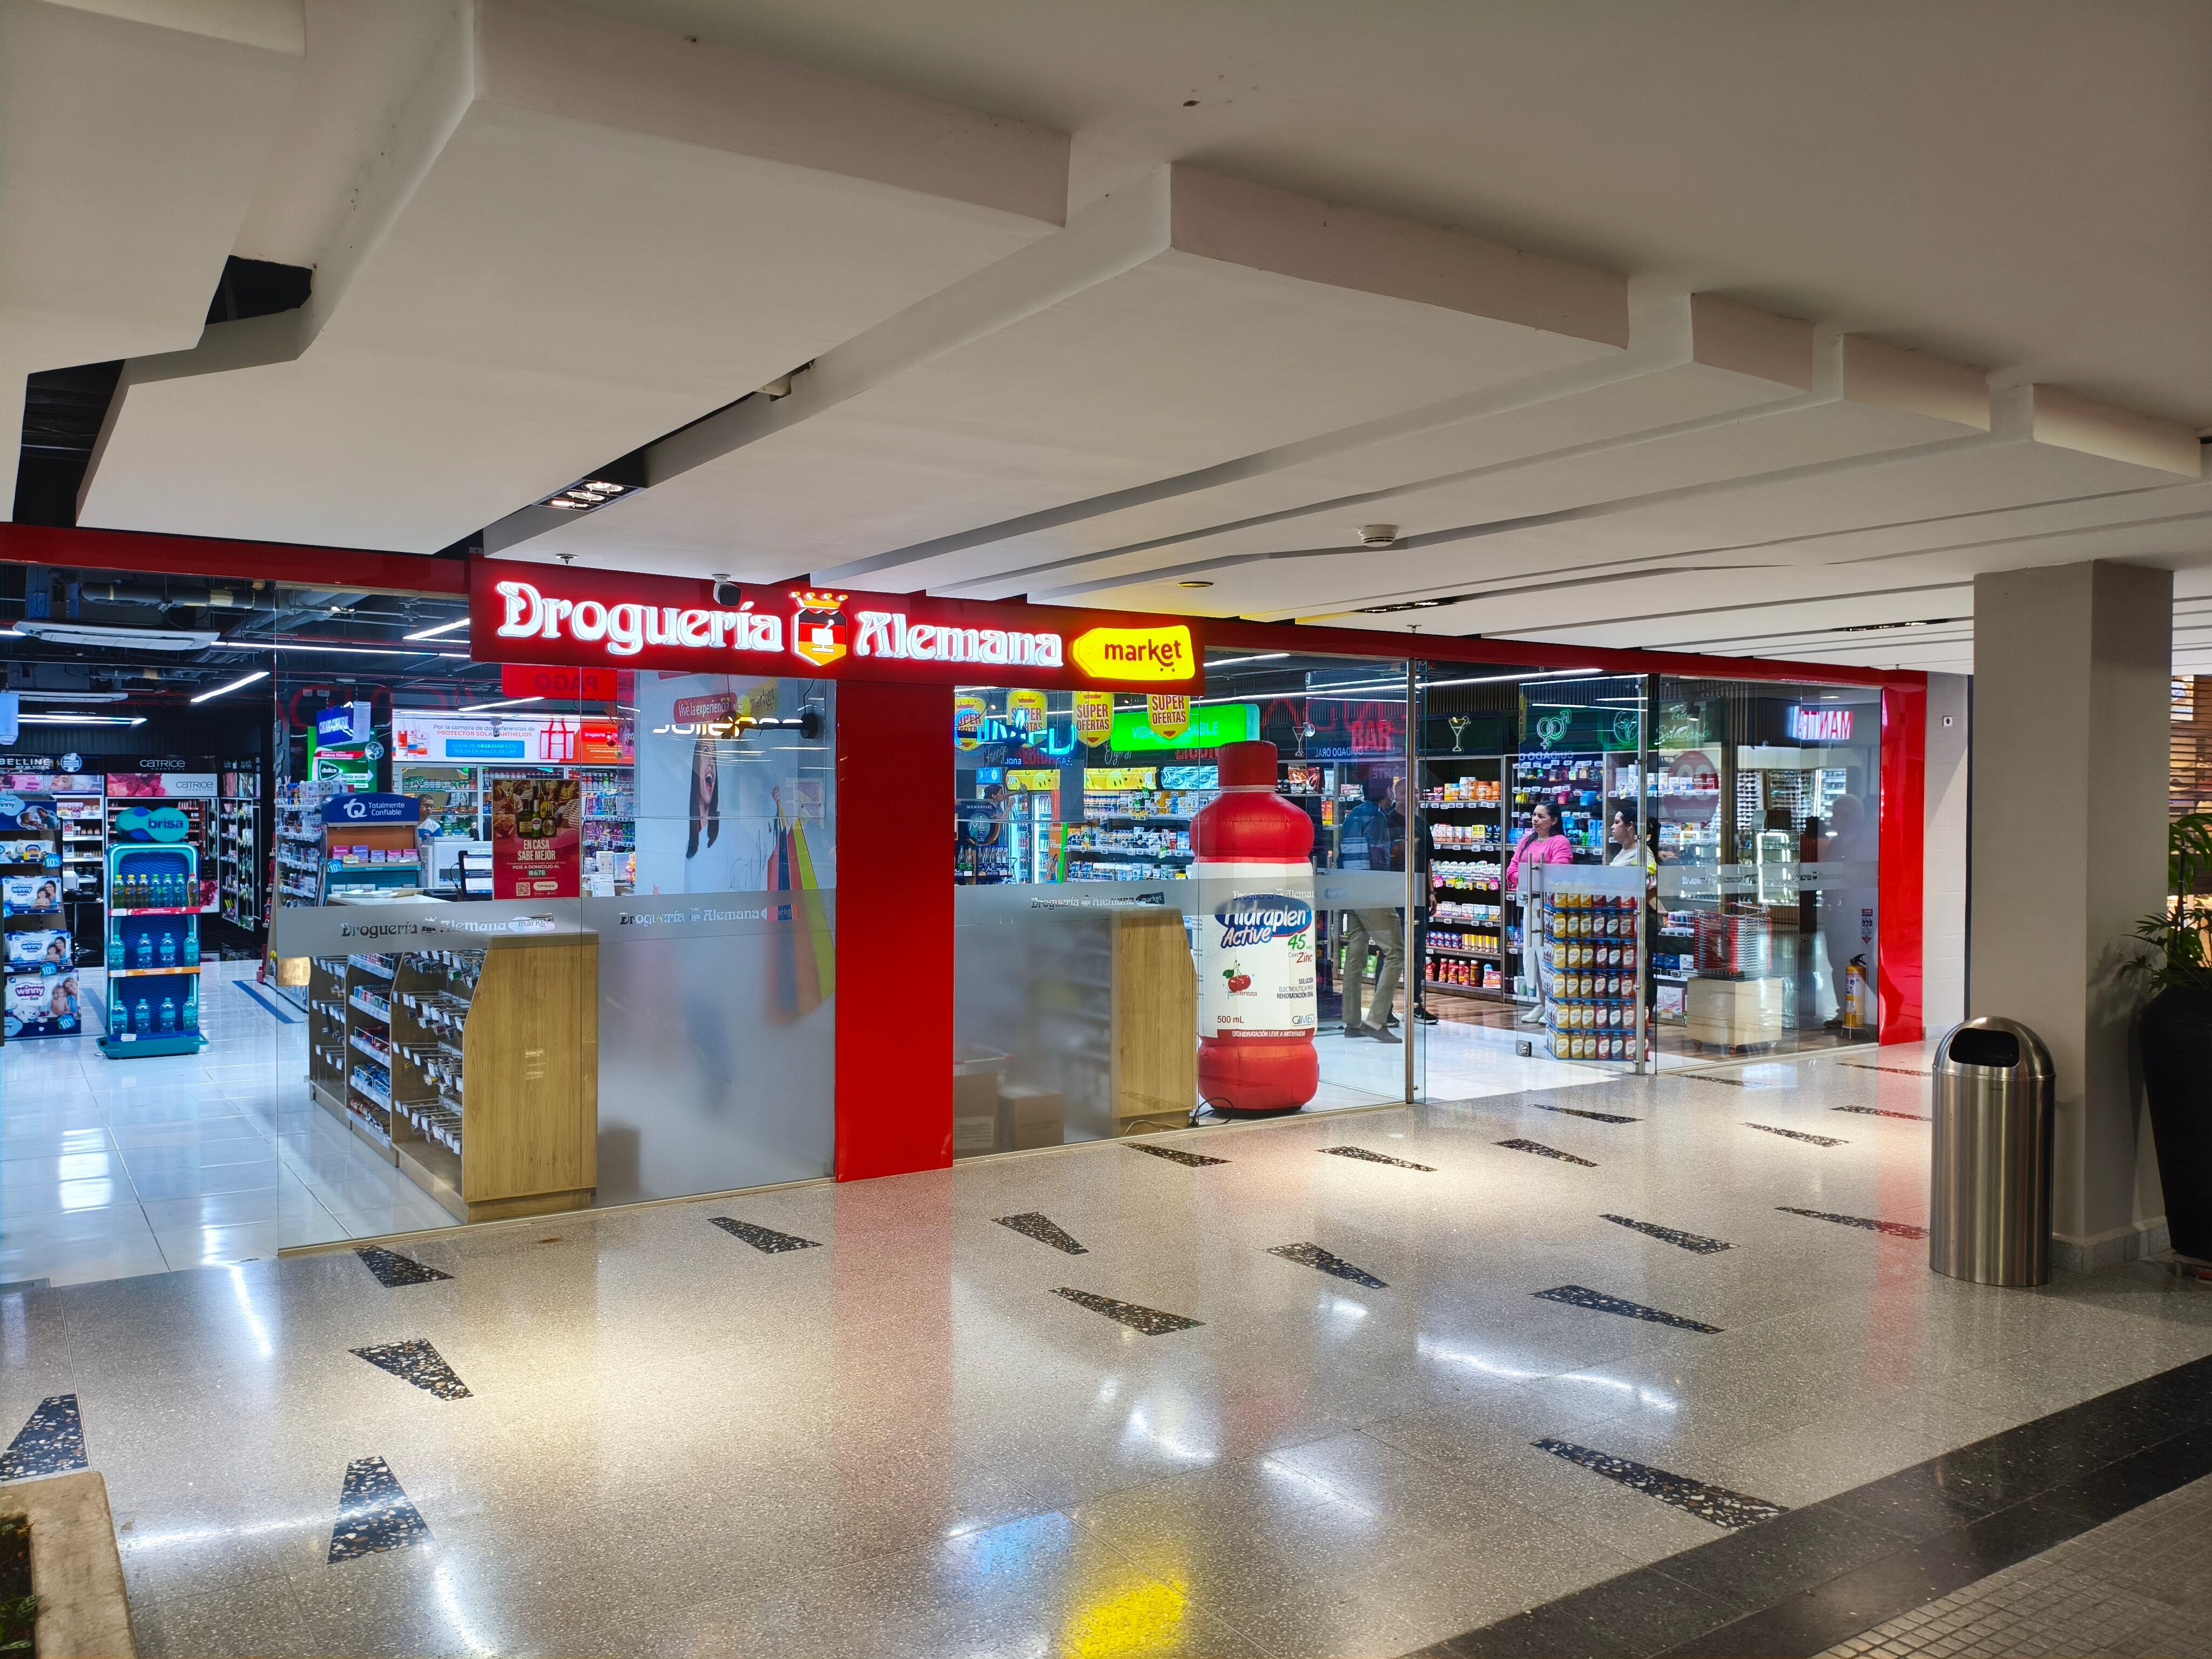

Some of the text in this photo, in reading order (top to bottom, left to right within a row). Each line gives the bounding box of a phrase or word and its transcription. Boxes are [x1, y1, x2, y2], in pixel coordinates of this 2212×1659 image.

[495, 581, 1063, 667] Droguería Alemana
[1104, 639, 1182, 667] market
[678, 704, 690, 717] Vive
[690, 703, 696, 716] la
[1076, 702, 1108, 718] SÚPER
[1076, 719, 1109, 731] OFERTAS
[1152, 711, 1186, 725] OFERTAS
[1352, 720, 1395, 752] BAR
[149, 817, 184, 829] brisa
[523, 839, 550, 850] EN CASA
[517, 850, 556, 861] SABE MEJOR
[1031, 896, 1080, 910] Droguería
[1142, 895, 1162, 905] market
[619, 910, 685, 926] Droguería
[704, 907, 759, 920] Alemana
[1224, 900, 1306, 933] Hidraplen
[341, 918, 551, 939] Droguería Alemana market
[1223, 927, 1271, 947] Active
[1288, 934, 1306, 950] 45
[1296, 952, 1313, 963] Zinc
[16, 986, 44, 996] winny
[1217, 1015, 1244, 1024] 500 mL
